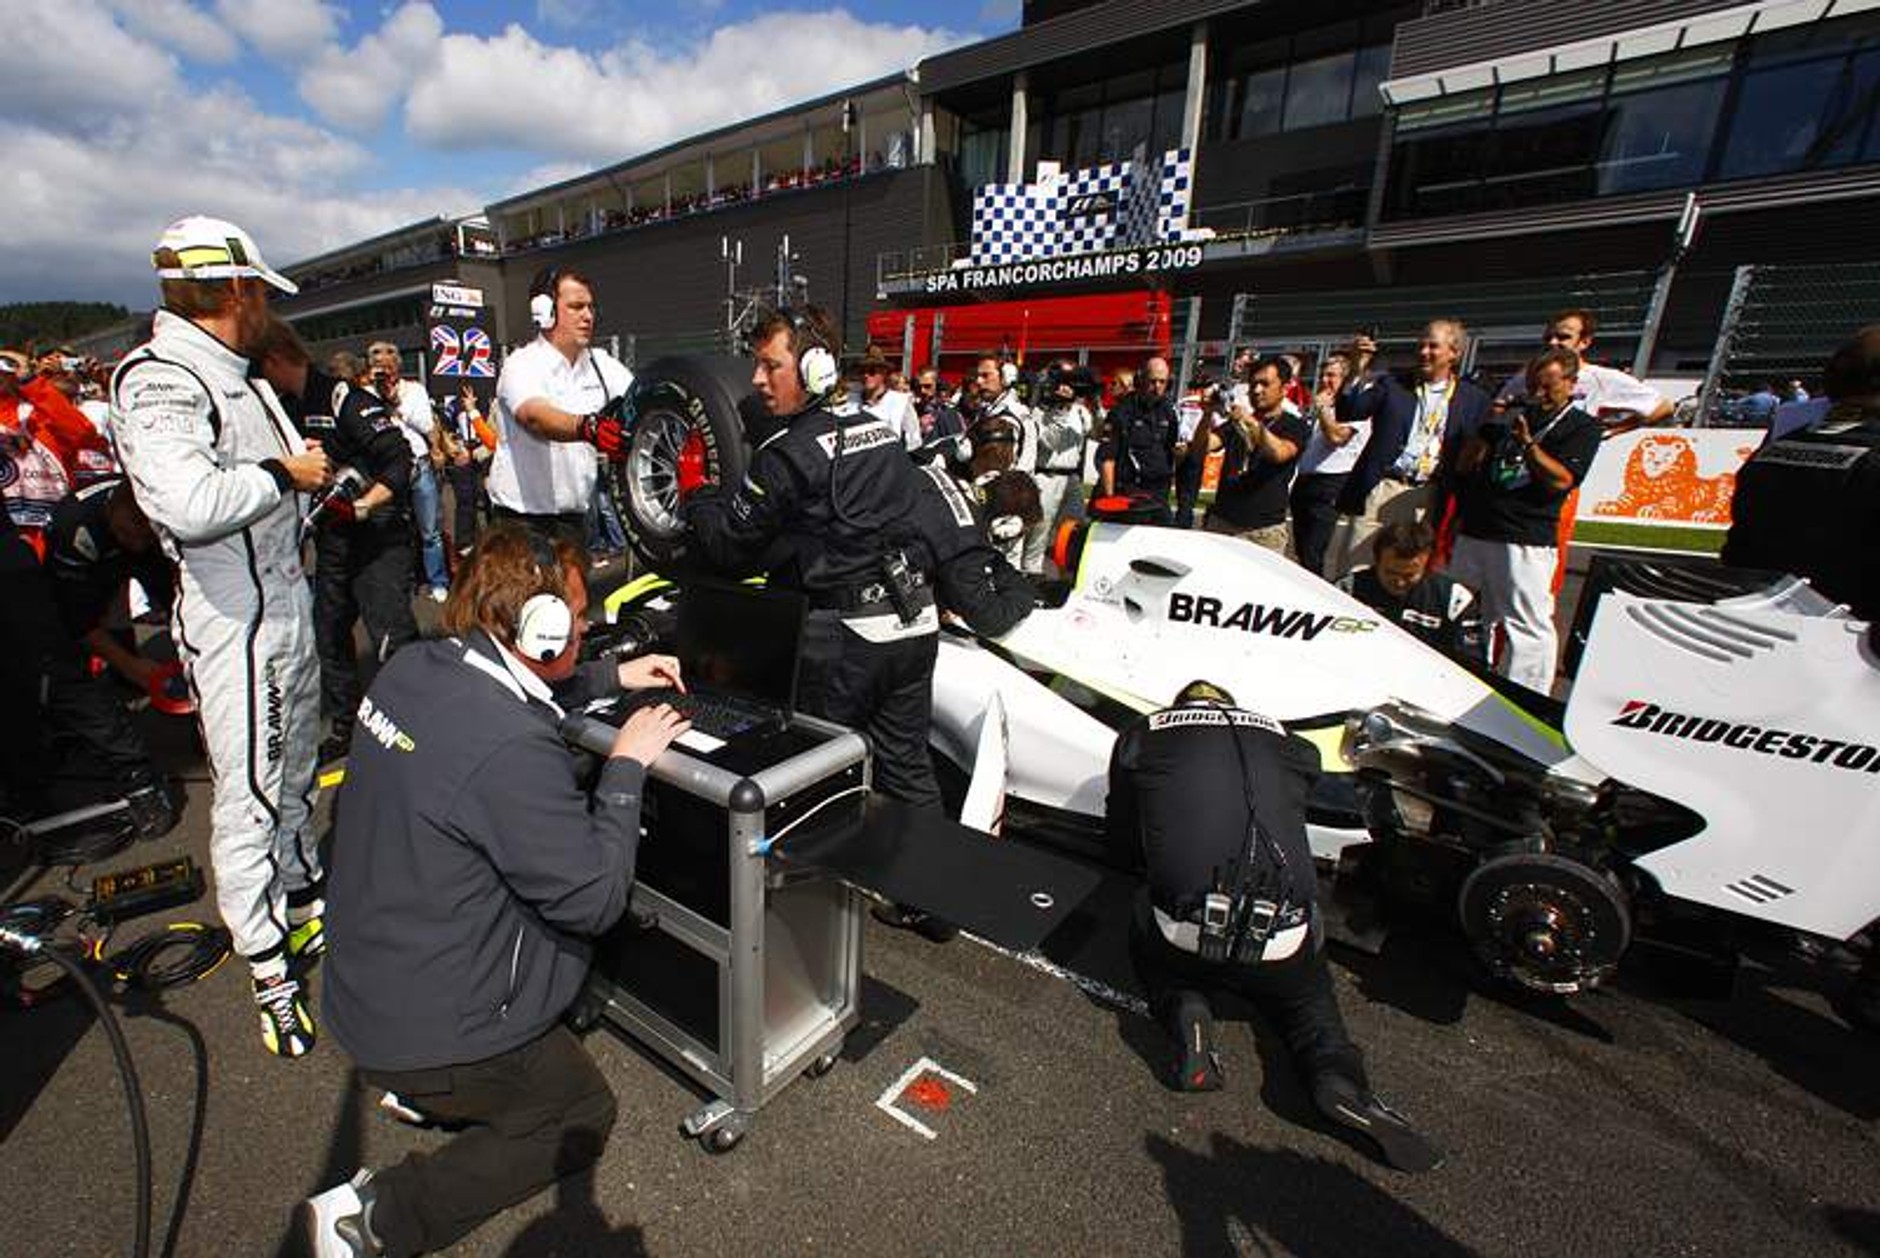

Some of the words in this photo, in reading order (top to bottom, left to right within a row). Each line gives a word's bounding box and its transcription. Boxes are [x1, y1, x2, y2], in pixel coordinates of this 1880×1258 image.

[926, 273, 958, 293] SPA
[963, 253, 1139, 288] FRANCORCHAMPS
[1145, 246, 1203, 270] 2009
[430, 324, 497, 378] 22
[1167, 592, 1334, 641] BRAWN
[267, 681, 282, 762] BRAWN
